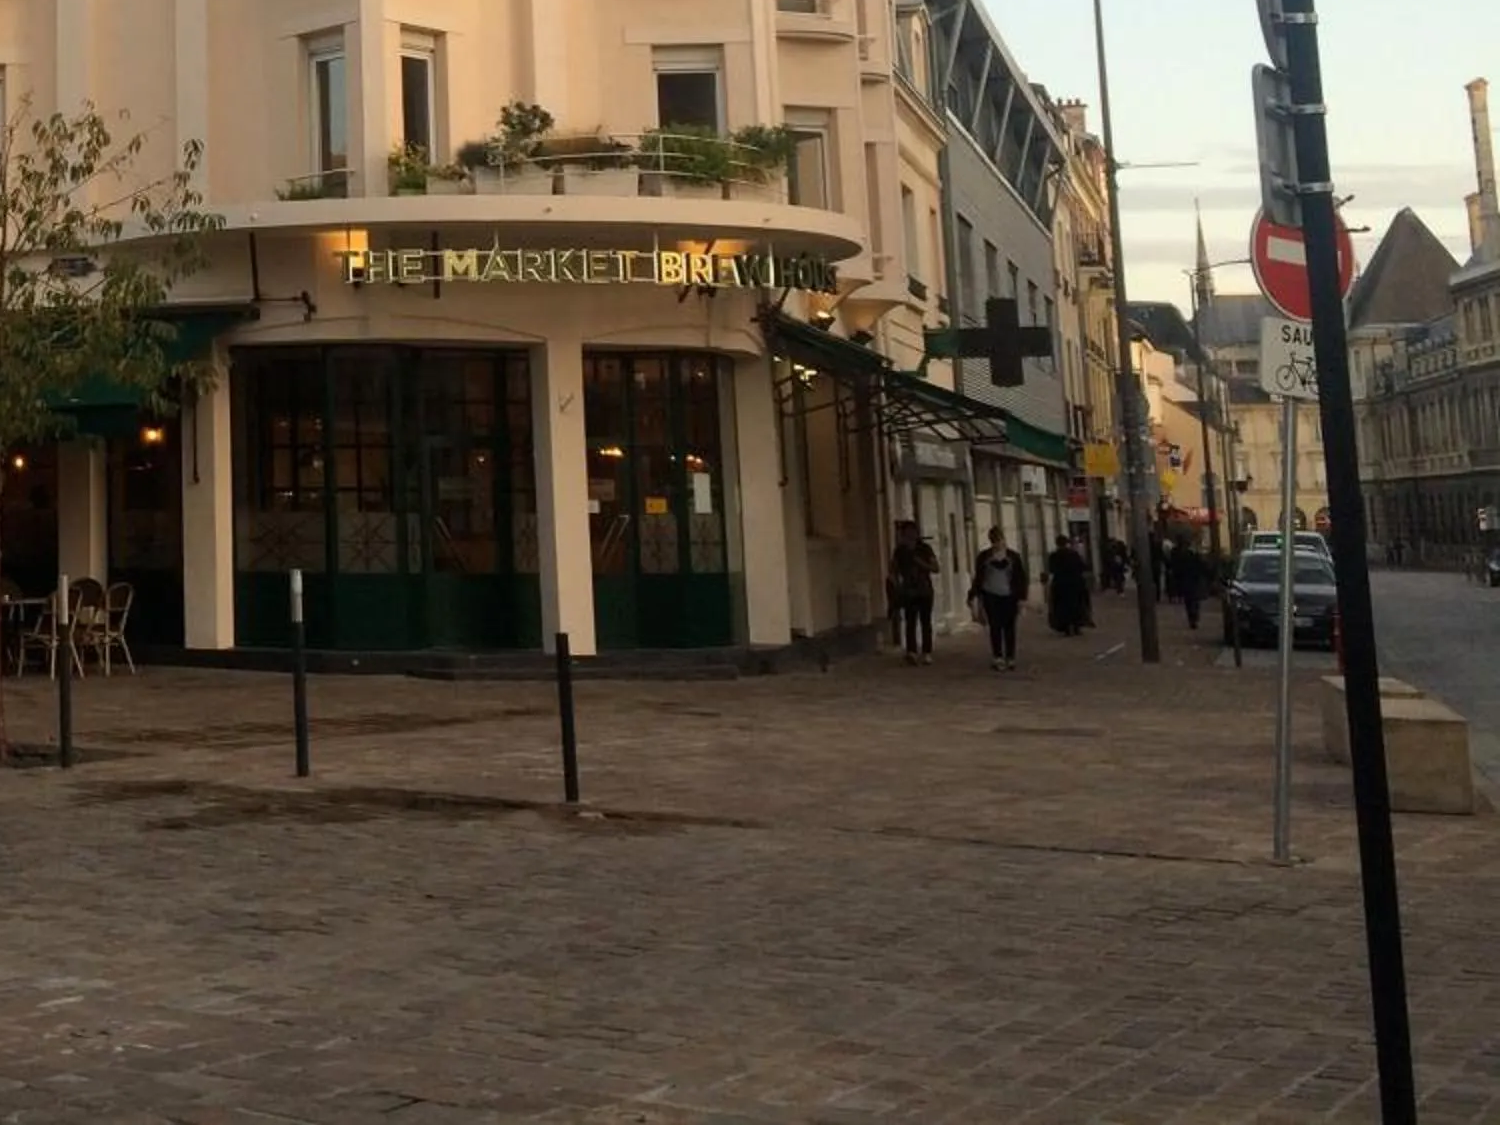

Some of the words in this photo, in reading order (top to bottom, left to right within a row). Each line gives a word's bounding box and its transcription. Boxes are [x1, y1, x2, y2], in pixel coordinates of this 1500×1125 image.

[333, 248, 425, 284] THE
[443, 247, 637, 284] MARKET
[653, 249, 769, 289] BREW
[1281, 323, 1313, 346] SAU
